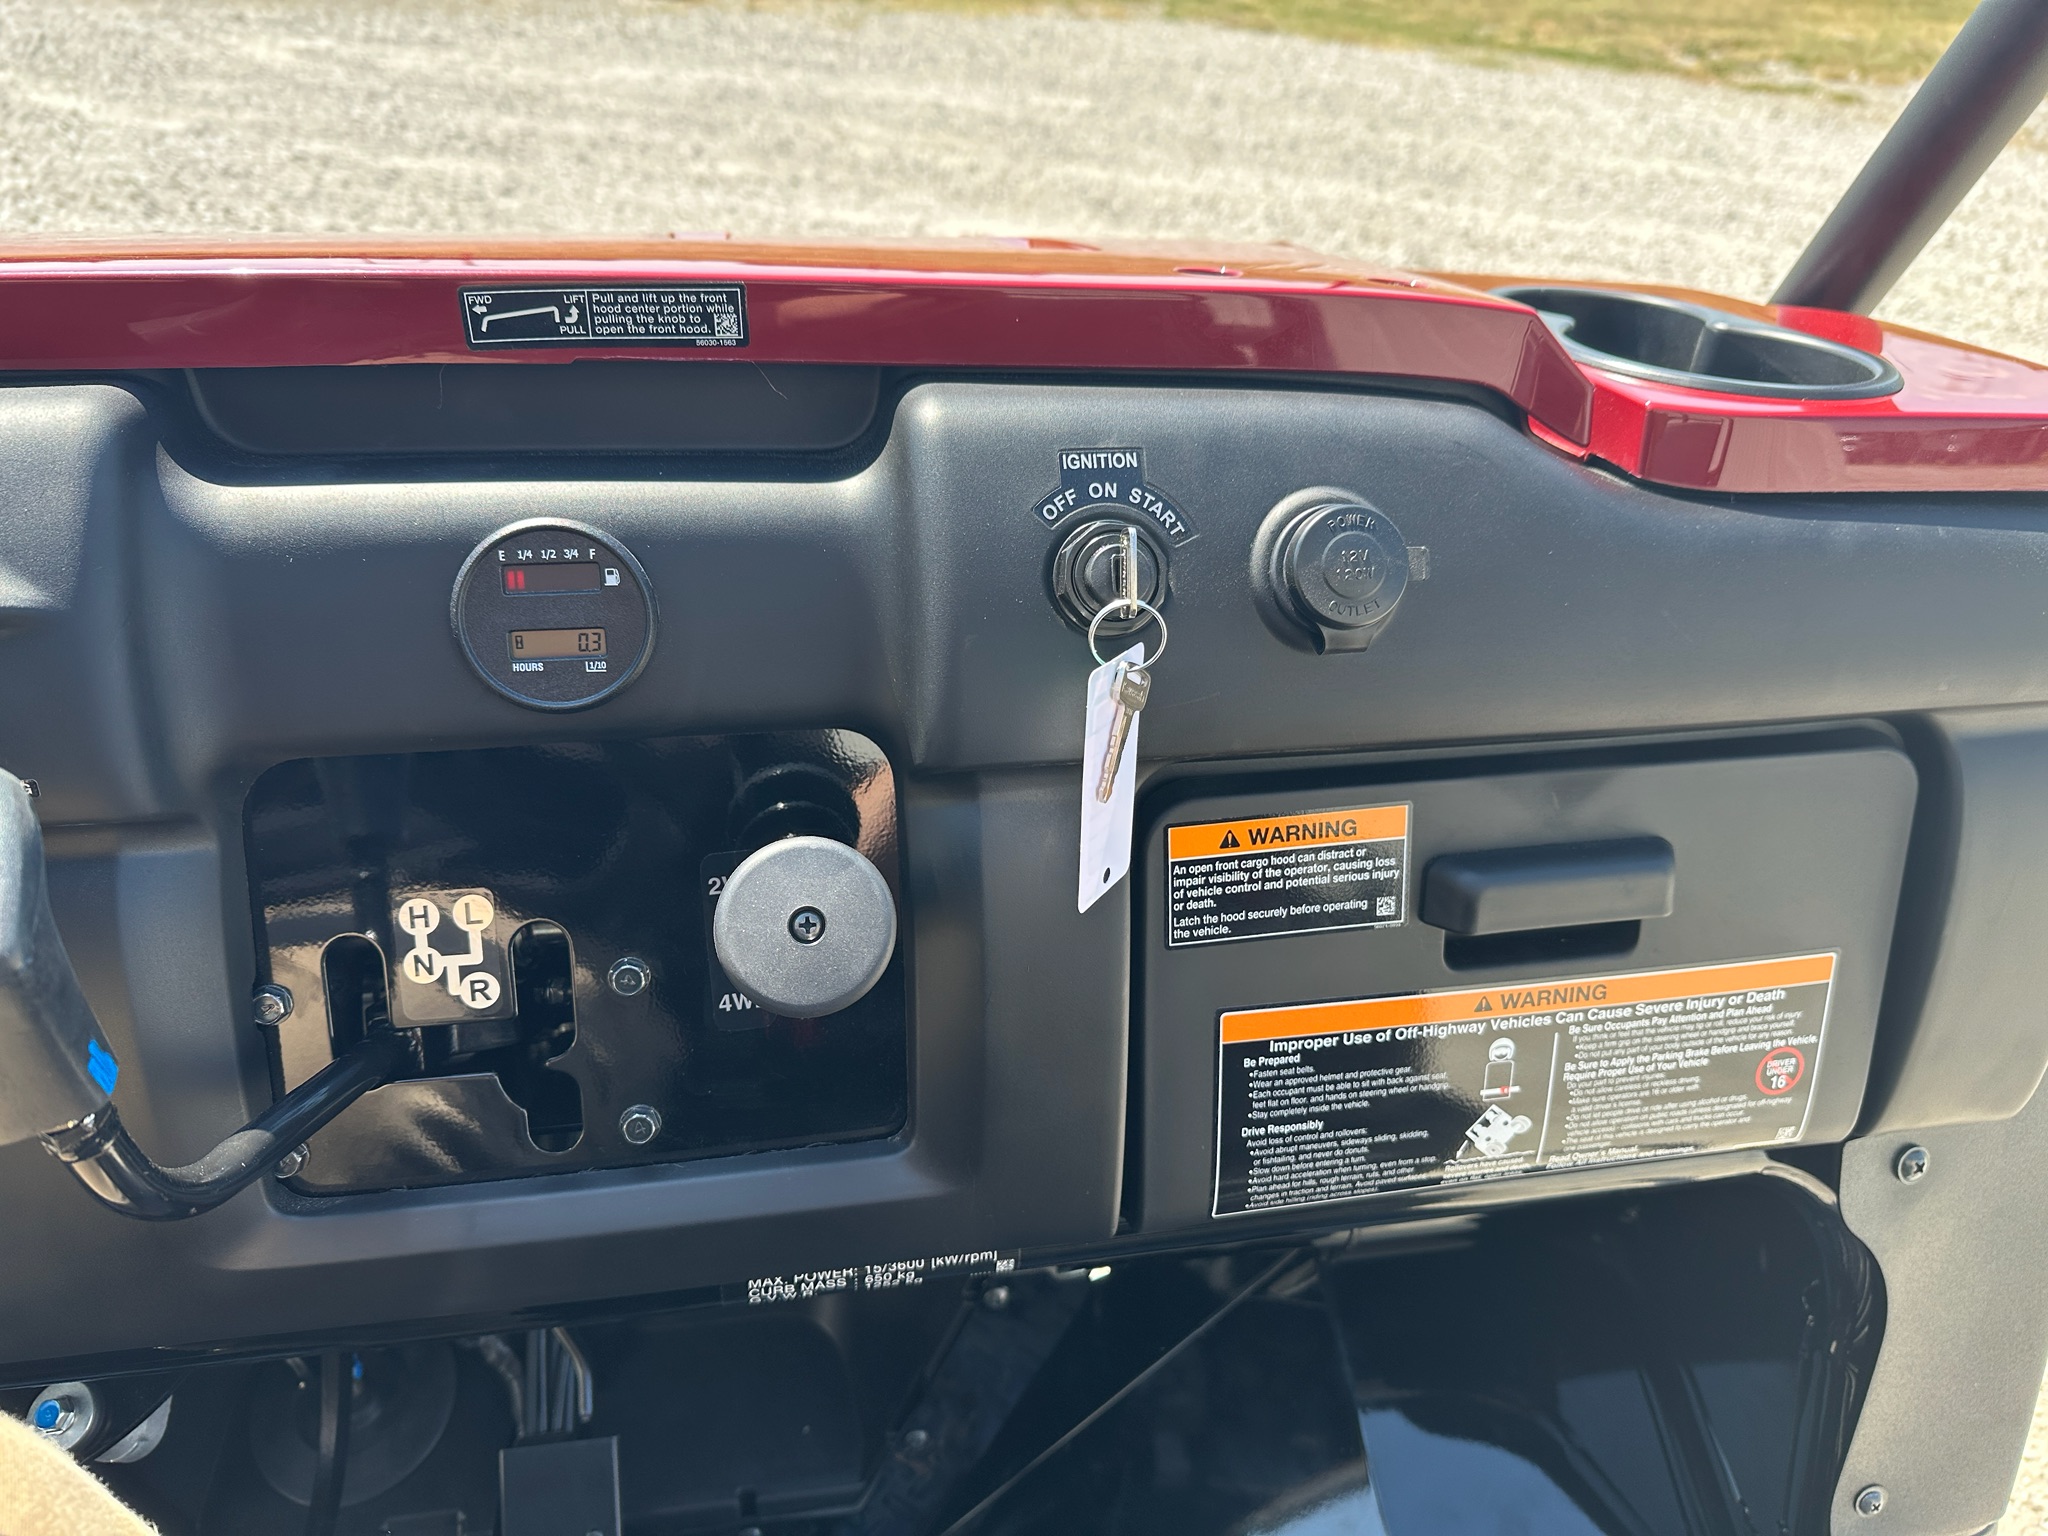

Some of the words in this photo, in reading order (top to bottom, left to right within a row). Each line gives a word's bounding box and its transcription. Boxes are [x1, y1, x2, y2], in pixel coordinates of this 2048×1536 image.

[468, 295, 492, 305] FWD
[564, 294, 585, 304] LIFT
[592, 293, 614, 303] Pull
[618, 293, 639, 303] and
[643, 292, 657, 303] lift
[661, 295, 676, 305] up
[679, 292, 697, 303] the
[700, 292, 727, 302] front
[593, 303, 621, 313] hood
[625, 303, 660, 313] center
[663, 303, 703, 315] portion
[706, 303, 734, 313] while
[595, 314, 632, 326] pulling
[636, 313, 655, 323] the
[658, 313, 686, 323] knob
[690, 313, 701, 323] to
[559, 325, 586, 335] PULL
[595, 326, 624, 336] open
[628, 324, 646, 334] the
[649, 324, 676, 334] front
[680, 324, 711, 333] hood.
[1062, 452, 1138, 470] IGNITION
[1042, 488, 1077, 521] OFF
[1088, 482, 1117, 498] ON
[1128, 487, 1185, 535] START
[1327, 514, 1376, 532] POWER
[499, 551, 505, 561] E
[517, 550, 533, 560] 1/4
[541, 549, 557, 559] 1/2
[563, 549, 579, 559] 3/4
[589, 549, 596, 559] F
[1341, 548, 1369, 562] 12V
[1336, 566, 1375, 580] 120W
[1328, 599, 1381, 616] OUTLET
[578, 632, 602, 653] 0.3
[512, 662, 544, 672] HOURS
[589, 661, 607, 670] 1/10
[1248, 819, 1357, 846] WARNING
[1173, 864, 1186, 875] An
[1189, 864, 1213, 876] open
[1215, 859, 1238, 871] front
[1241, 858, 1268, 870] cargo
[1271, 853, 1295, 866] hood
[1298, 853, 1315, 863] can
[1317, 847, 1354, 861] distract
[1356, 848, 1367, 857] or
[1173, 874, 1206, 889] impair
[1208, 870, 1249, 884] visibility
[1252, 868, 1262, 880] of
[1265, 867, 1281, 878] the
[1284, 863, 1331, 878] operator,
[1333, 859, 1372, 872] causing
[1375, 857, 1396, 868] loss
[1173, 888, 1184, 899] of
[1187, 885, 1223, 898] vehicle
[1225, 880, 1261, 894] control
[1264, 878, 1283, 890] and
[1286, 874, 1330, 891] potential
[1332, 871, 1369, 884] serious
[1372, 868, 1400, 882] injury
[1173, 902, 1185, 911] or
[1186, 897, 1217, 910] death.
[1174, 914, 1200, 927] Latch
[1203, 913, 1219, 924] the
[1221, 910, 1245, 922] hood
[1248, 906, 1288, 920] securely
[1290, 904, 1320, 915] before
[1323, 898, 1368, 914] operating
[409, 905, 430, 929] H
[464, 902, 484, 925] L
[1173, 927, 1190, 939] the
[1193, 924, 1232, 937] vehicle.
[413, 953, 434, 977] N
[469, 979, 492, 1002] R
[719, 993, 761, 1012] 4W
[1500, 984, 1607, 1010] WARNING
[1269, 1036, 1338, 1053] Improper
[1342, 1032, 1371, 1045] Use
[1376, 1028, 1392, 1042] of
[1395, 1023, 1486, 1040] Off-Highway
[1490, 1015, 1552, 1031] Vehicles
[1556, 1011, 1584, 1024] Can
[1587, 1007, 1632, 1021] Cause
[1635, 1002, 1684, 1016] Severe
[1686, 997, 1725, 1012] Injury
[1728, 995, 1744, 1006] or
[1746, 988, 1786, 1004] Death
[1569, 1025, 1581, 1034] Be
[1582, 1023, 1603, 1033] Sure
[1604, 1017, 1650, 1031] Occupants
[1651, 1016, 1667, 1027] Pay
[1669, 1012, 1707, 1024] Attention
[1709, 1009, 1725, 1020] and
[1726, 1008, 1745, 1018] Plan
[1745, 1004, 1774, 1016] Ahead
[1243, 1058, 1256, 1068] Be
[1258, 1054, 1301, 1068] Prepared
[1564, 1062, 1577, 1072] Be
[1578, 1060, 1599, 1070] Sure
[1599, 1058, 1610, 1068] to
[1610, 1055, 1634, 1068] Apply
[1637, 1053, 1650, 1063] the
[1651, 1050, 1684, 1062] Parking
[1685, 1046, 1709, 1058] Brake
[1711, 1044, 1739, 1055] Before
[1739, 1040, 1771, 1052] Leaving
[1773, 1037, 1787, 1048] the
[1787, 1034, 1818, 1046] Vehicle.
[1253, 1068, 1278, 1078] Fasten
[1280, 1066, 1295, 1075] seat
[1296, 1064, 1315, 1074] belts.
[1563, 1069, 1597, 1082] Require
[1598, 1067, 1627, 1078] Proper
[1628, 1064, 1644, 1074] Use
[1646, 1061, 1655, 1072] of
[1656, 1061, 1677, 1071] Your
[1678, 1056, 1710, 1068] Vehicle
[1766, 1057, 1796, 1068] DRIVER
[1766, 1066, 1794, 1076] UNDER
[1253, 1080, 1272, 1088] Wear
[1285, 1073, 1318, 1087] approved
[1319, 1071, 1343, 1081] helmet
[1345, 1069, 1359, 1079] and
[1360, 1066, 1394, 1079] protective
[1395, 1065, 1413, 1075] gear.
[1771, 1074, 1787, 1089] 16
[1252, 1110, 1268, 1120] Stay
[1269, 1105, 1307, 1118] completely
[1309, 1103, 1329, 1113] inside
[1331, 1102, 1342, 1111] the
[1344, 1099, 1370, 1109] vehicle.
[1241, 1127, 1266, 1137] Drive
[1267, 1120, 1324, 1136] Responsibly
[1246, 1137, 1267, 1148] Avoid
[1269, 1137, 1283, 1145] loss
[1285, 1134, 1293, 1143] of
[1294, 1131, 1318, 1142] control
[1320, 1129, 1334, 1139] and
[1335, 1127, 1368, 1137] rollovers:
[748, 1276, 788, 1290] MAX.
[748, 1284, 796, 1298] CURB
[801, 1278, 847, 1291] MASS
[865, 1272, 893, 1283] 650
